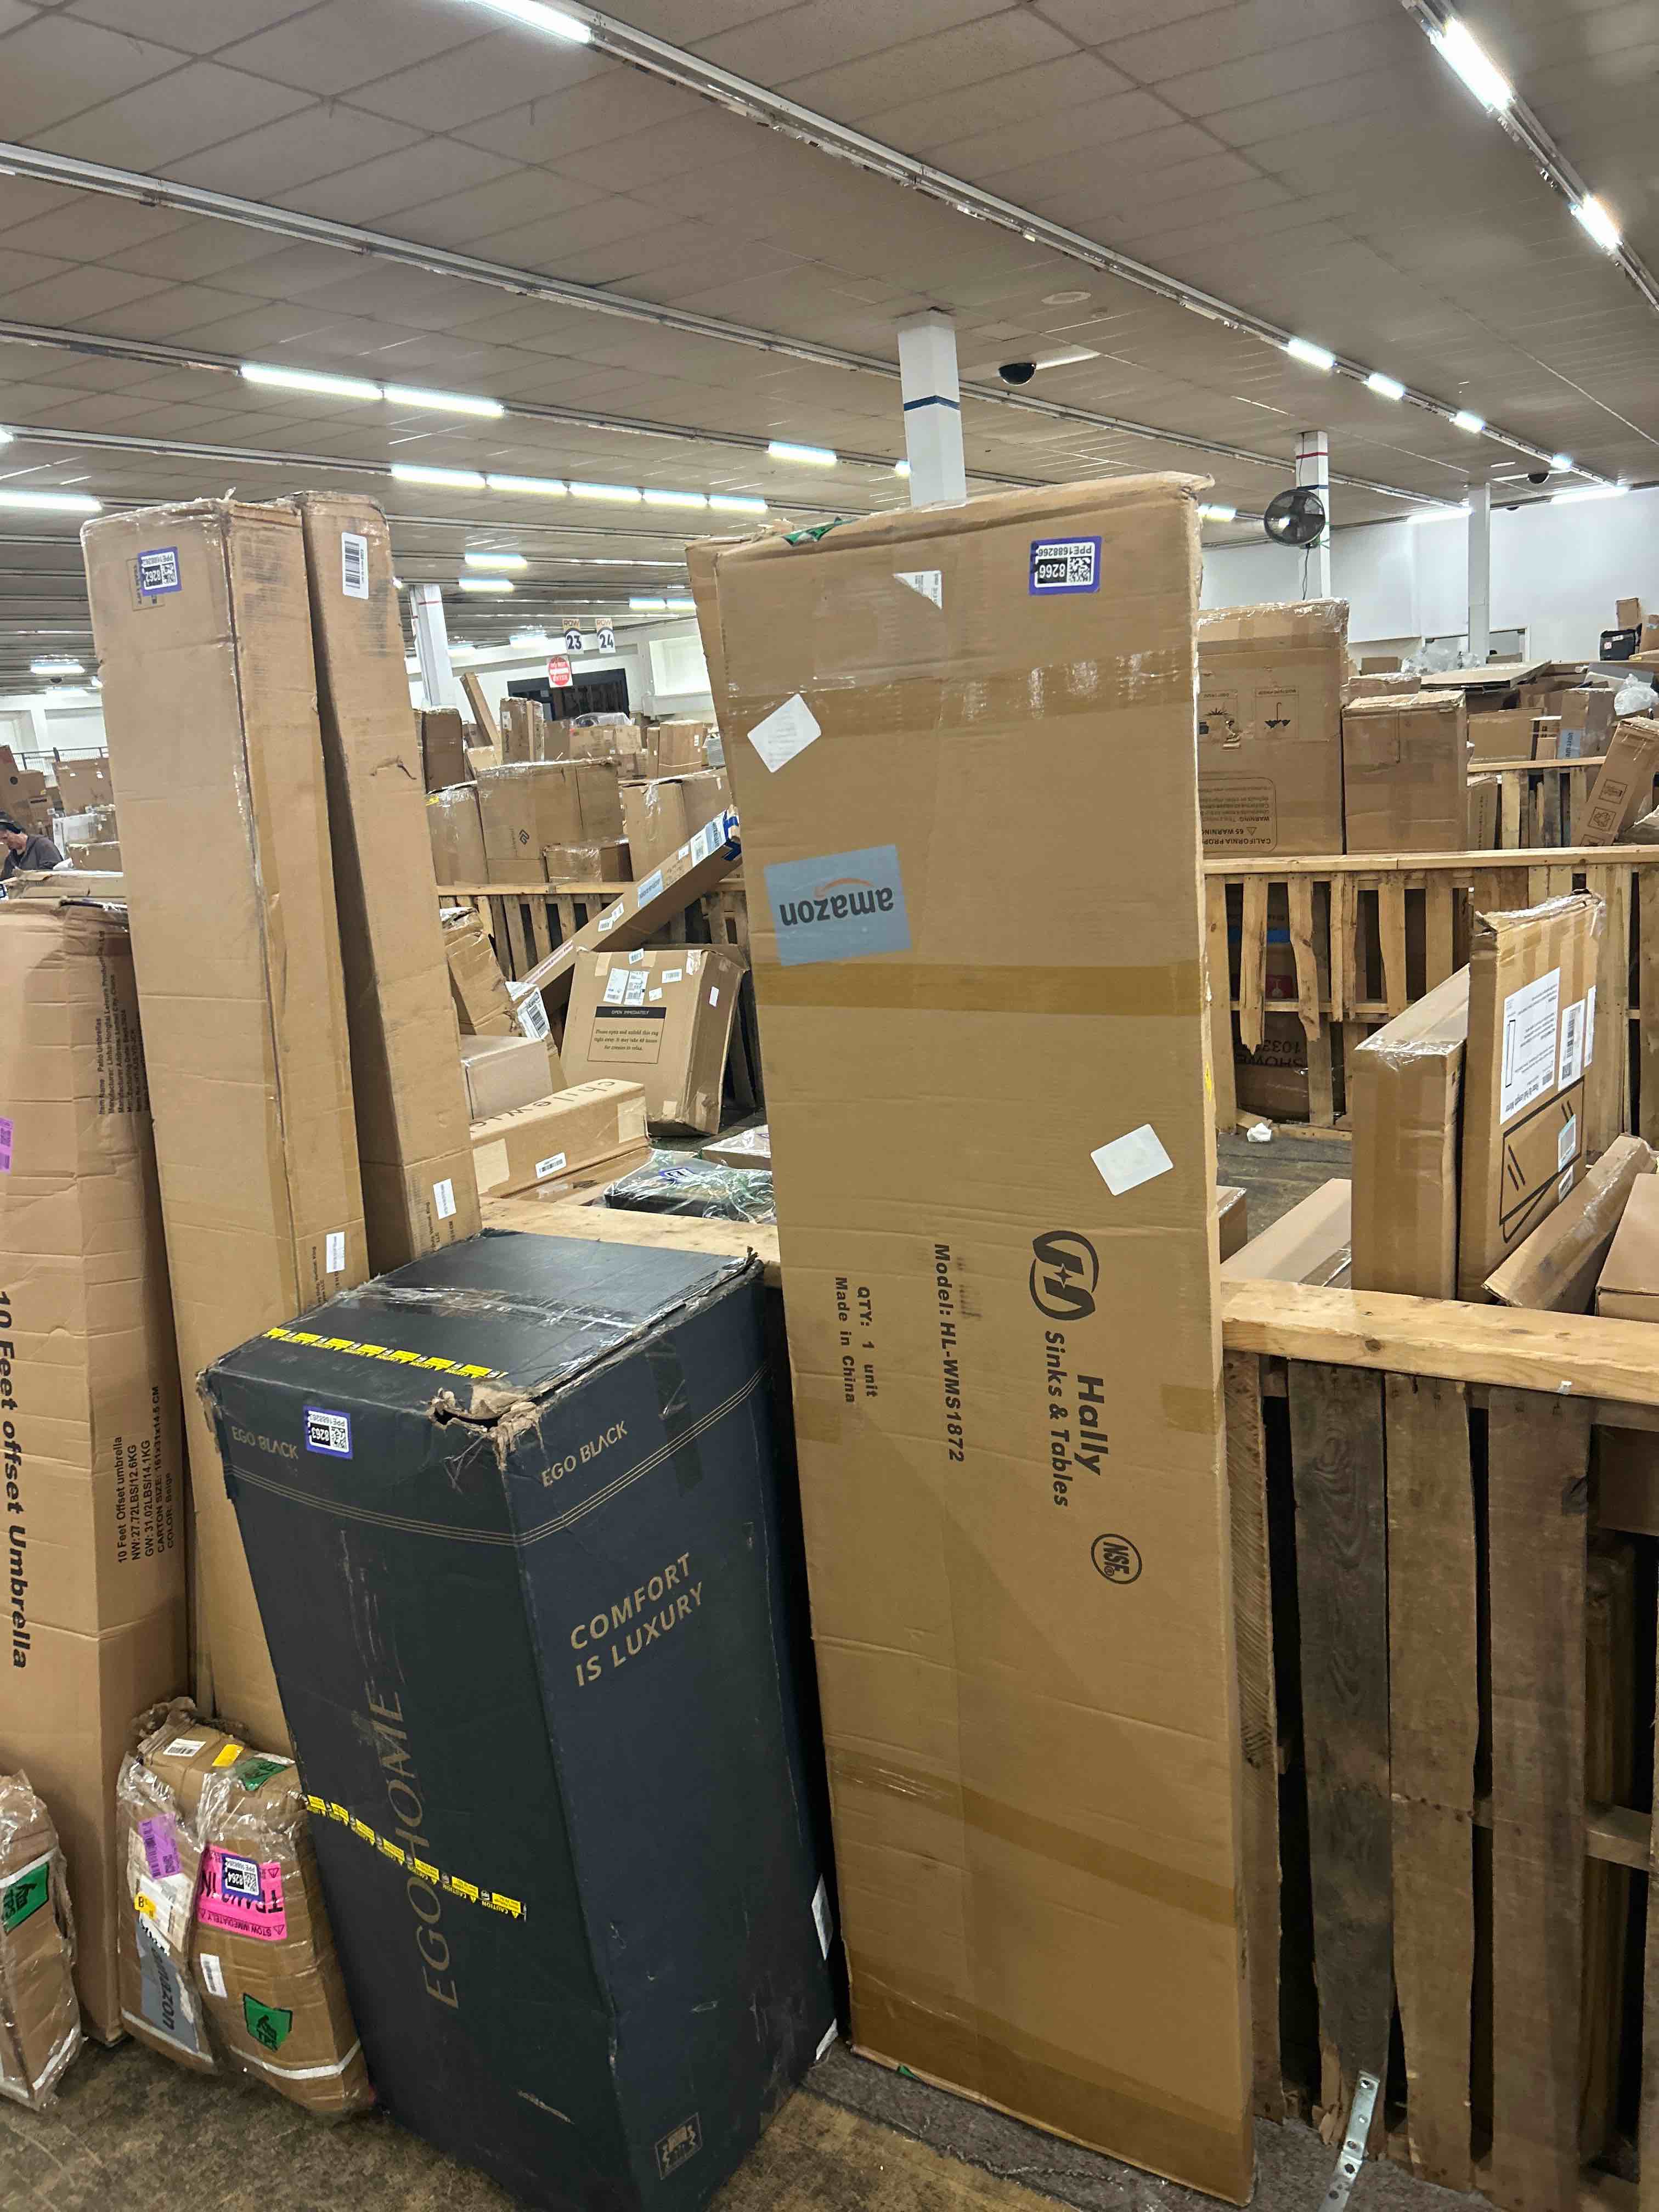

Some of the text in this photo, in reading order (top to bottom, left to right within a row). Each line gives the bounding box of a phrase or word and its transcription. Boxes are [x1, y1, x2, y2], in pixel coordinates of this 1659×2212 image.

[145, 569, 161, 583] 8262
[1038, 545, 1092, 556] PPE1688266
[1039, 563, 1065, 578] 8266
[567, 635, 582, 650] 23
[599, 634, 614, 648] 24
[779, 887, 894, 926] amazon
[835, 1277, 856, 1403] Made in China
[857, 1286, 877, 1398] QTY: 1 unit
[934, 1244, 964, 1462] Model: HL-WMS1872
[231, 1426, 298, 1459] EGO BLACK
[311, 1427, 329, 1442] 8263
[1045, 1330, 1073, 1507] Sinks & Tables
[1074, 1374, 1109, 1476] Hally
[0, 1291, 31, 1669] 10 Feet offset Umbrella
[541, 1420, 628, 1488] EGO BLACK
[113, 1436, 127, 1563] 10 Feet Offset umbrella
[156, 1505, 165, 1553] CARTON
[571, 1552, 690, 1650] COMFORT
[575, 1582, 702, 1686] IS LUXURY
[208, 1913, 272, 1937] STOW IMMEDIATELY
[482, 1900, 509, 1914] CAUTION
[407, 1876, 459, 2010] EGO
